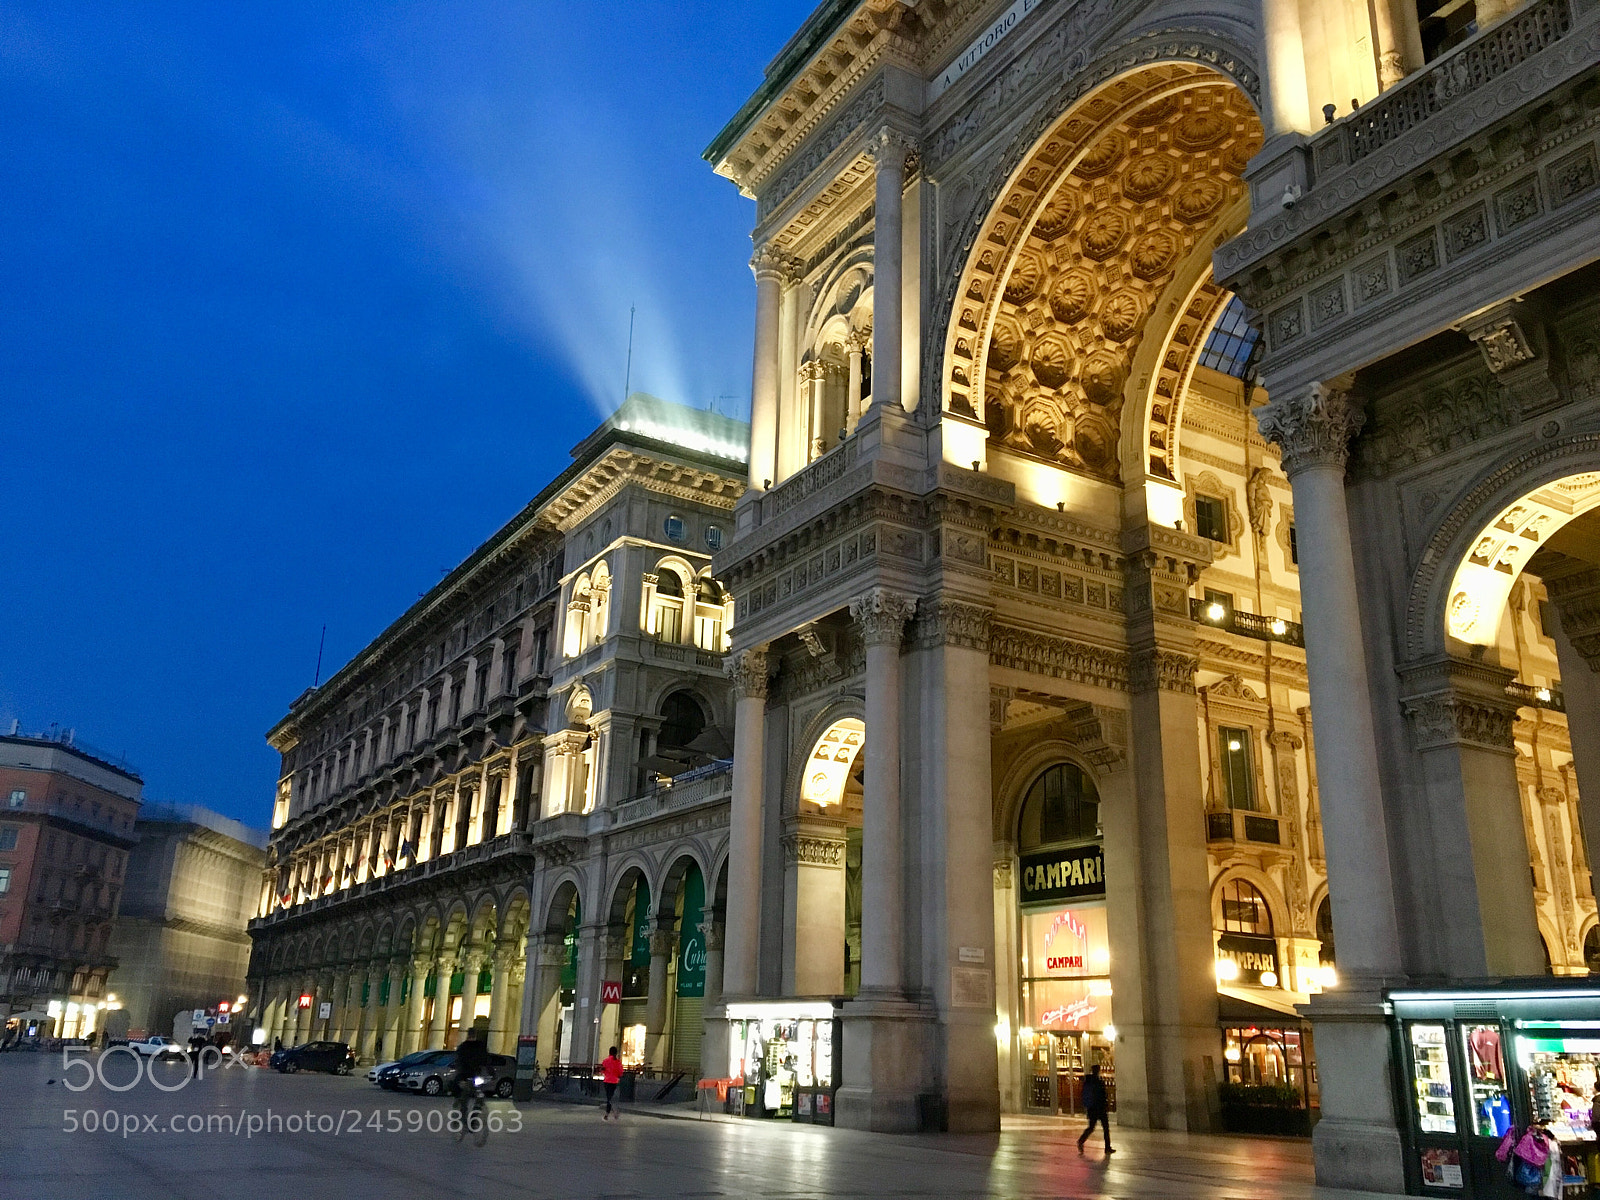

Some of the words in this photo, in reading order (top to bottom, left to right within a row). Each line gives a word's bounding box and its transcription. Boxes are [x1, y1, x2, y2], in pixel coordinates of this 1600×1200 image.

[943, 74, 951, 88] A
[958, 12, 1016, 72] VITTORIO
[1024, 856, 1103, 892] CAMPARI
[1047, 955, 1083, 969] CAMPARI
[603, 985, 620, 999] M
